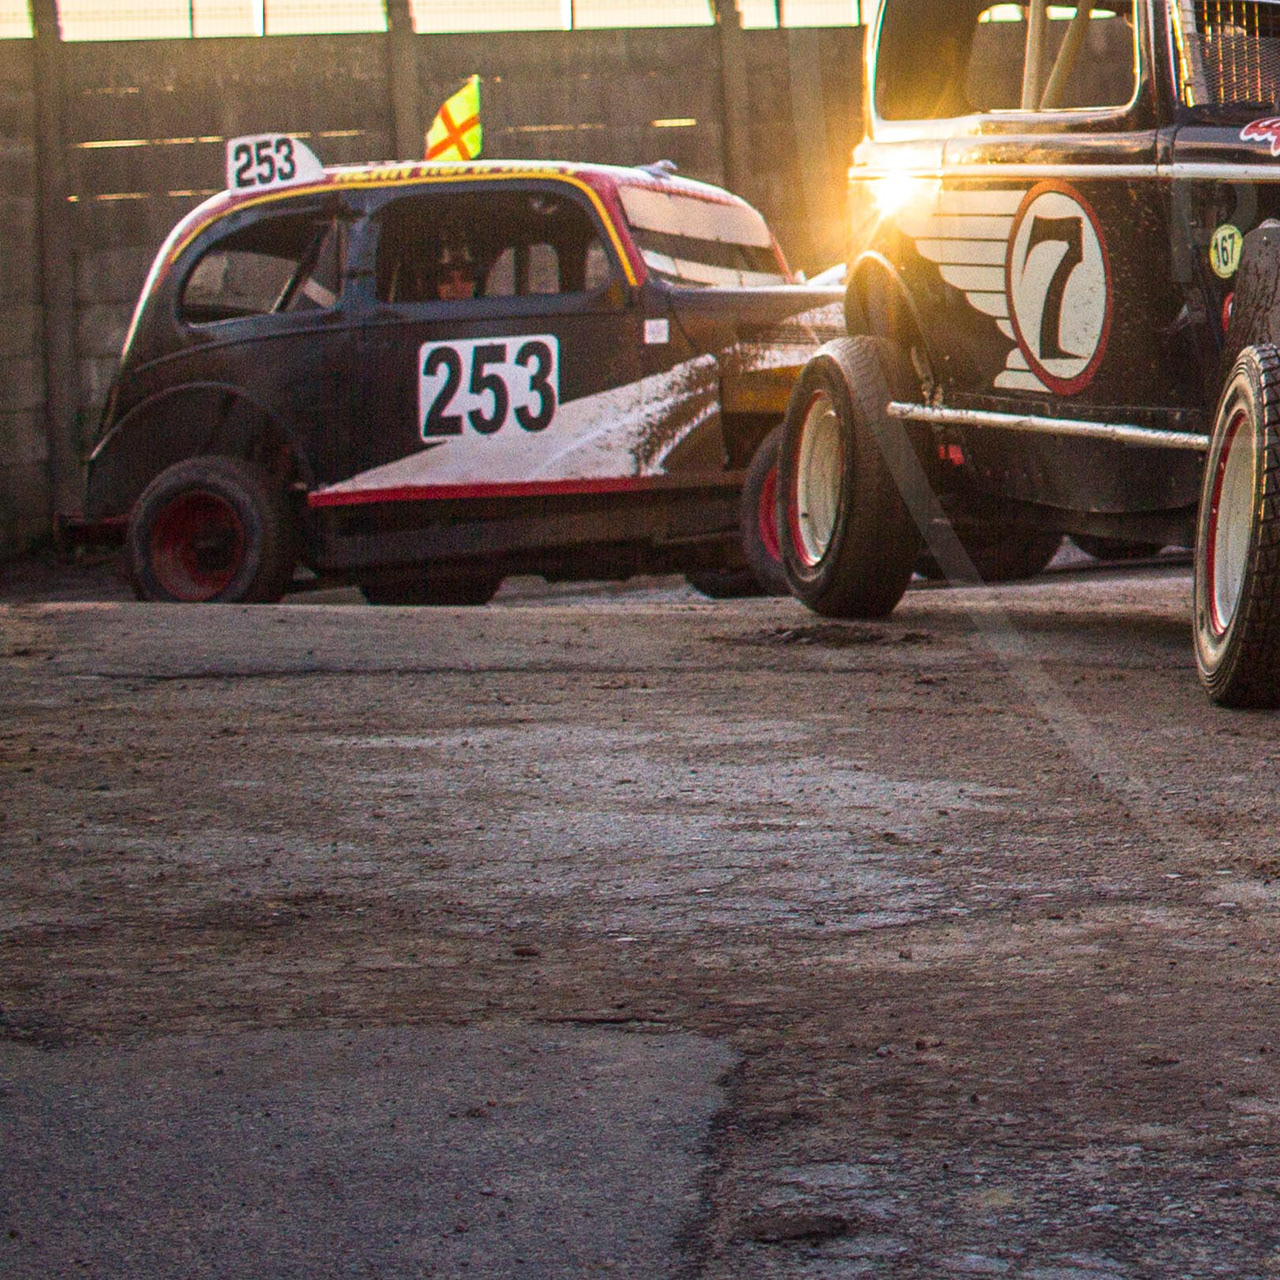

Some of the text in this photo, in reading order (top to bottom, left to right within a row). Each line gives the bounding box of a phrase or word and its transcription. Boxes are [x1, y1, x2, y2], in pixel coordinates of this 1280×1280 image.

[233, 138, 296, 188] 253
[1019, 215, 1088, 360] 7
[1214, 232, 1236, 270] 167
[423, 340, 558, 436] 253
